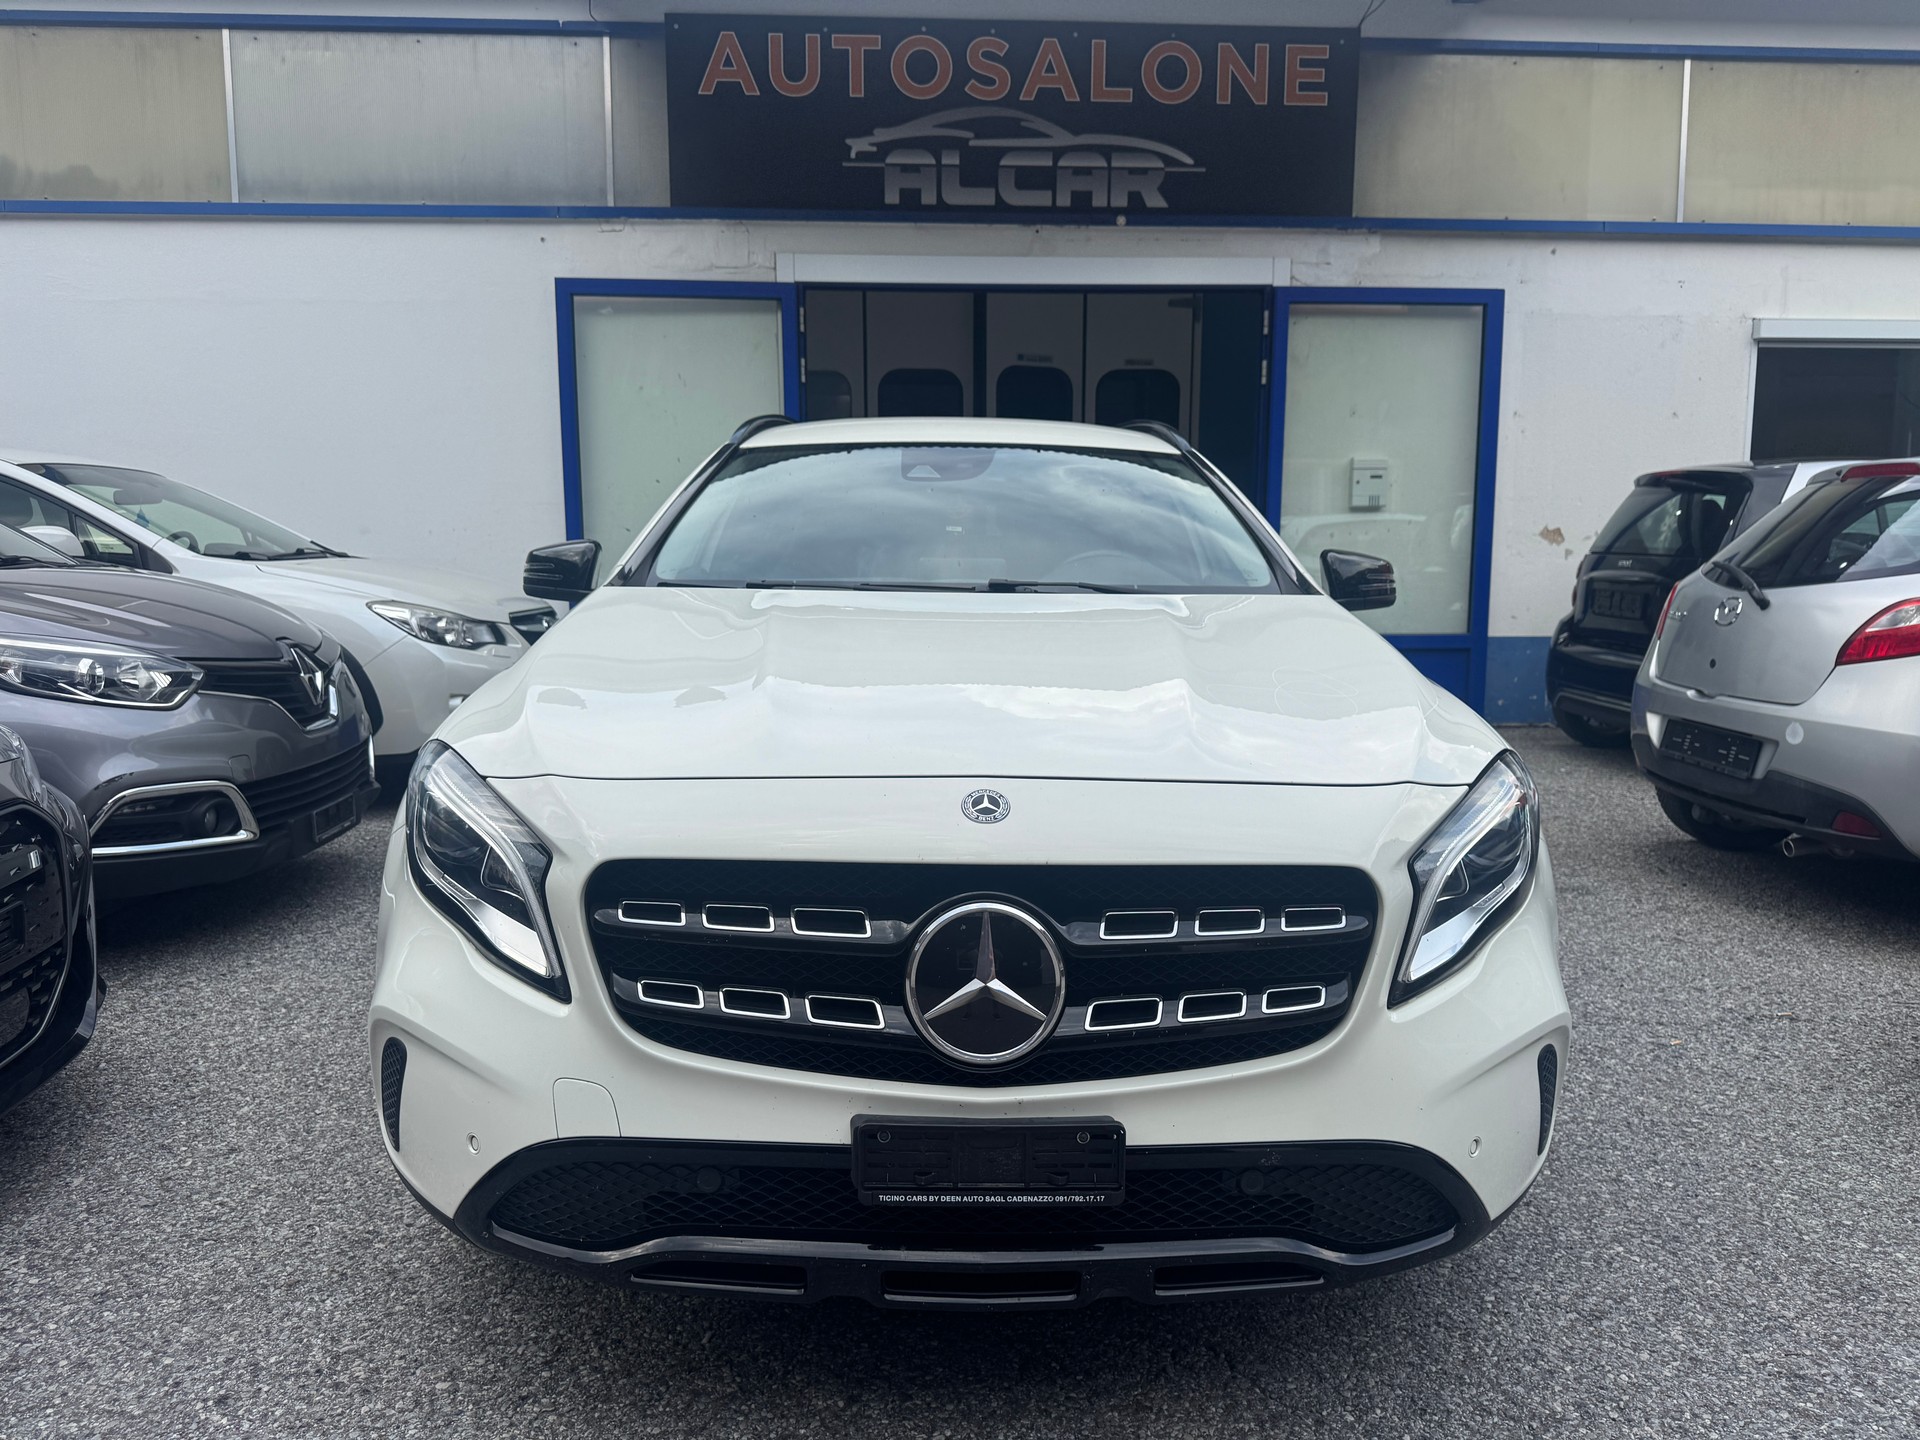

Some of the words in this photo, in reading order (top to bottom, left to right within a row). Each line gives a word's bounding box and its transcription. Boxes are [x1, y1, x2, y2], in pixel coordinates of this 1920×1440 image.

[698, 31, 1330, 107] AUTOSALONE
[884, 149, 1169, 208] ALCAR
[962, 1195, 984, 1203] AUTO
[985, 1195, 1006, 1203] SAGL
[1006, 1195, 1054, 1203] CADENAZZO
